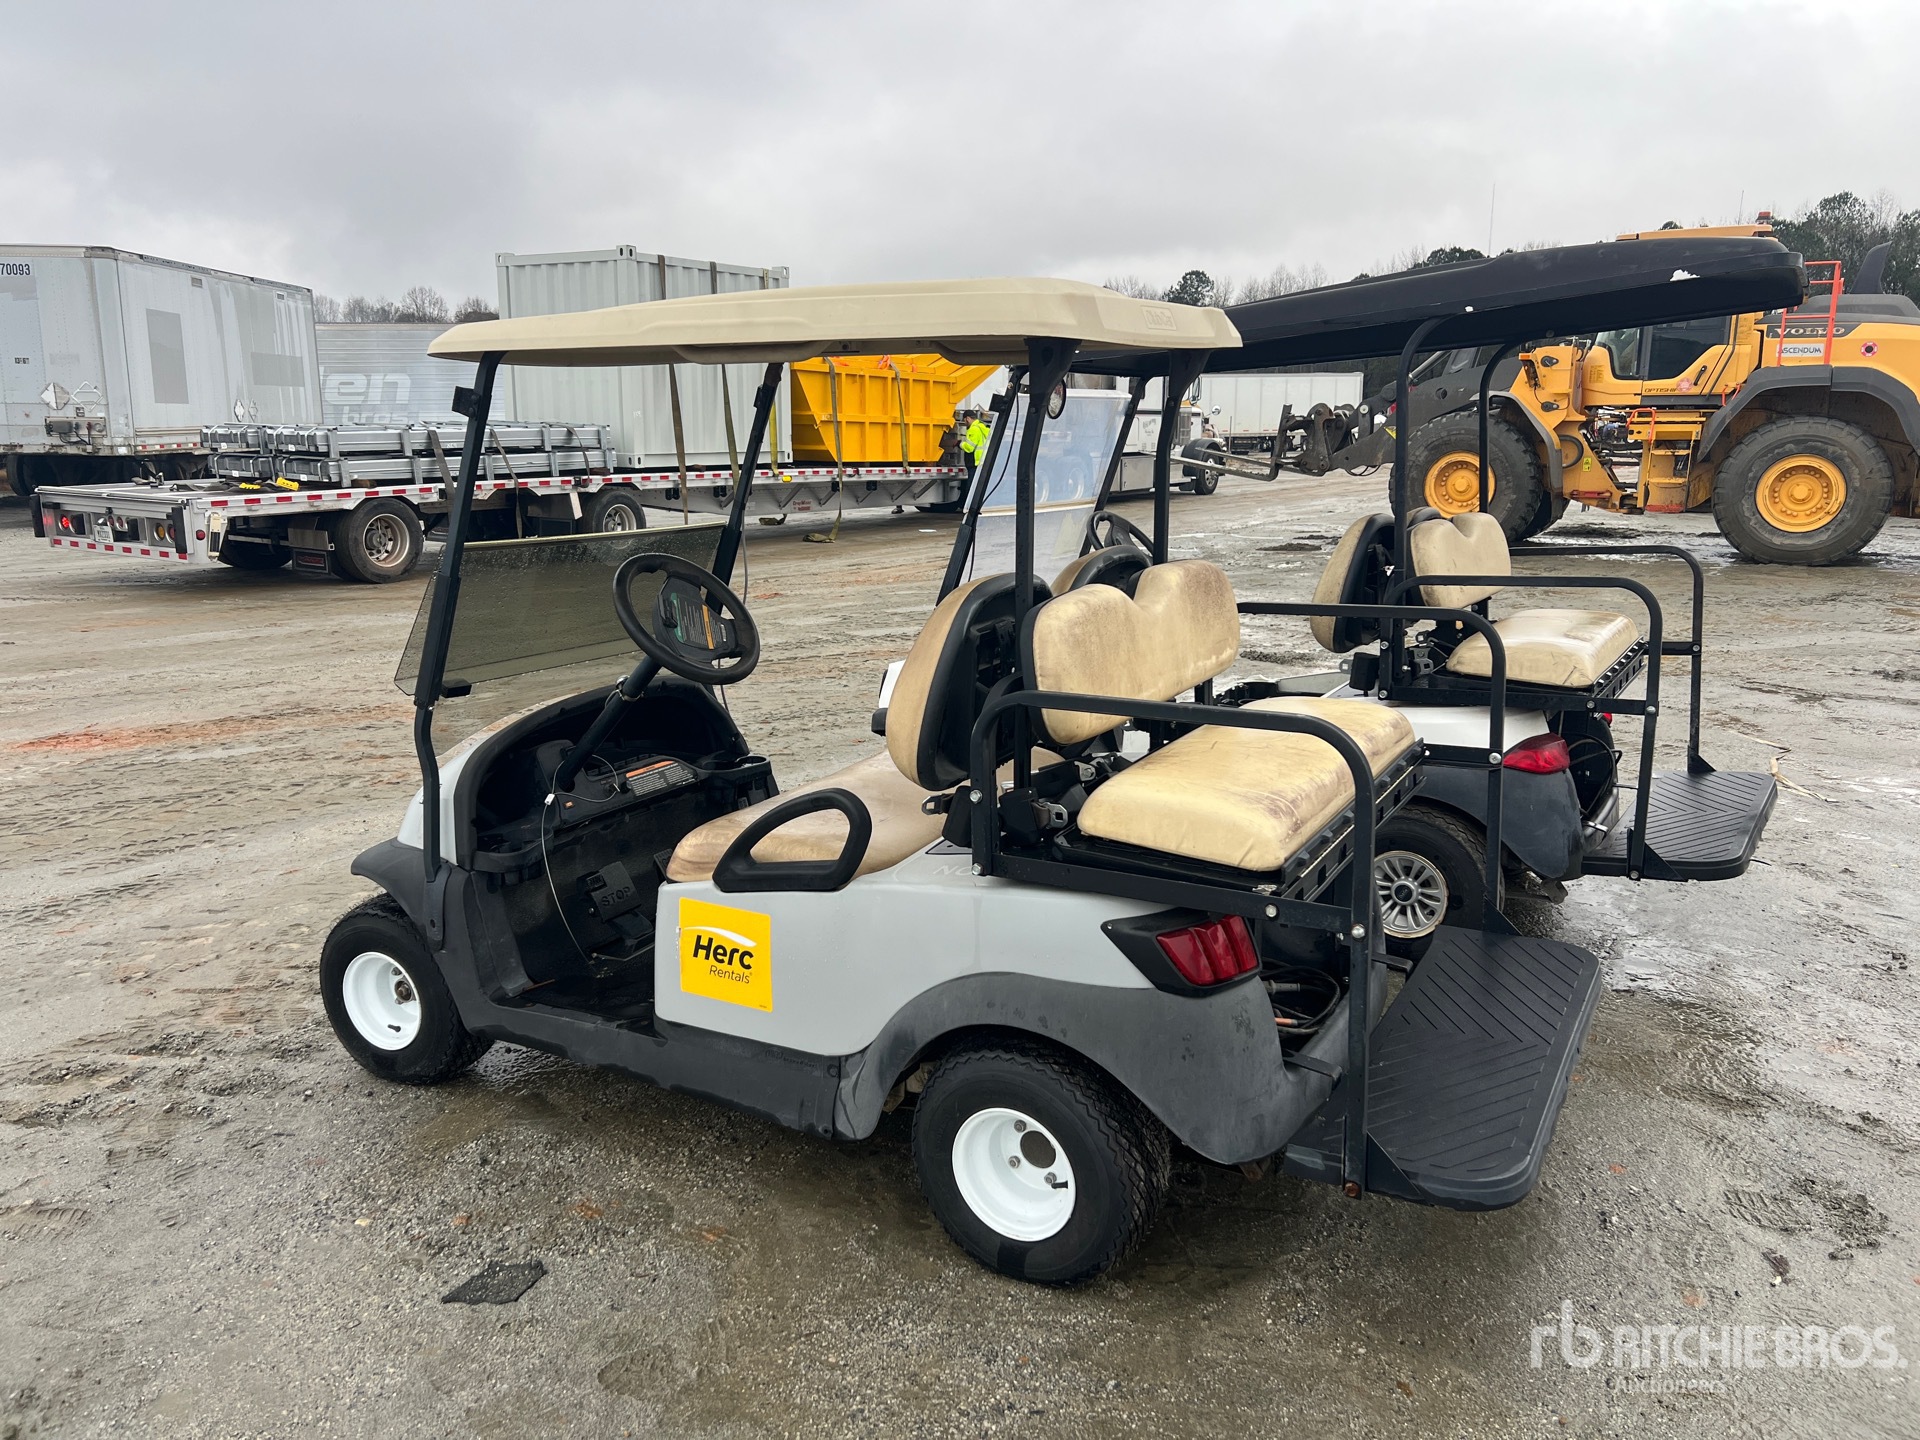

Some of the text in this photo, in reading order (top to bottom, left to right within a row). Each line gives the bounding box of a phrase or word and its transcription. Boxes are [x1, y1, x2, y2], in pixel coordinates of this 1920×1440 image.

[1774, 326, 1846, 336] VOLVO
[319, 367, 411, 405] en
[601, 886, 631, 907] STOP
[692, 934, 754, 970] Herc
[709, 964, 751, 984] Rentals
